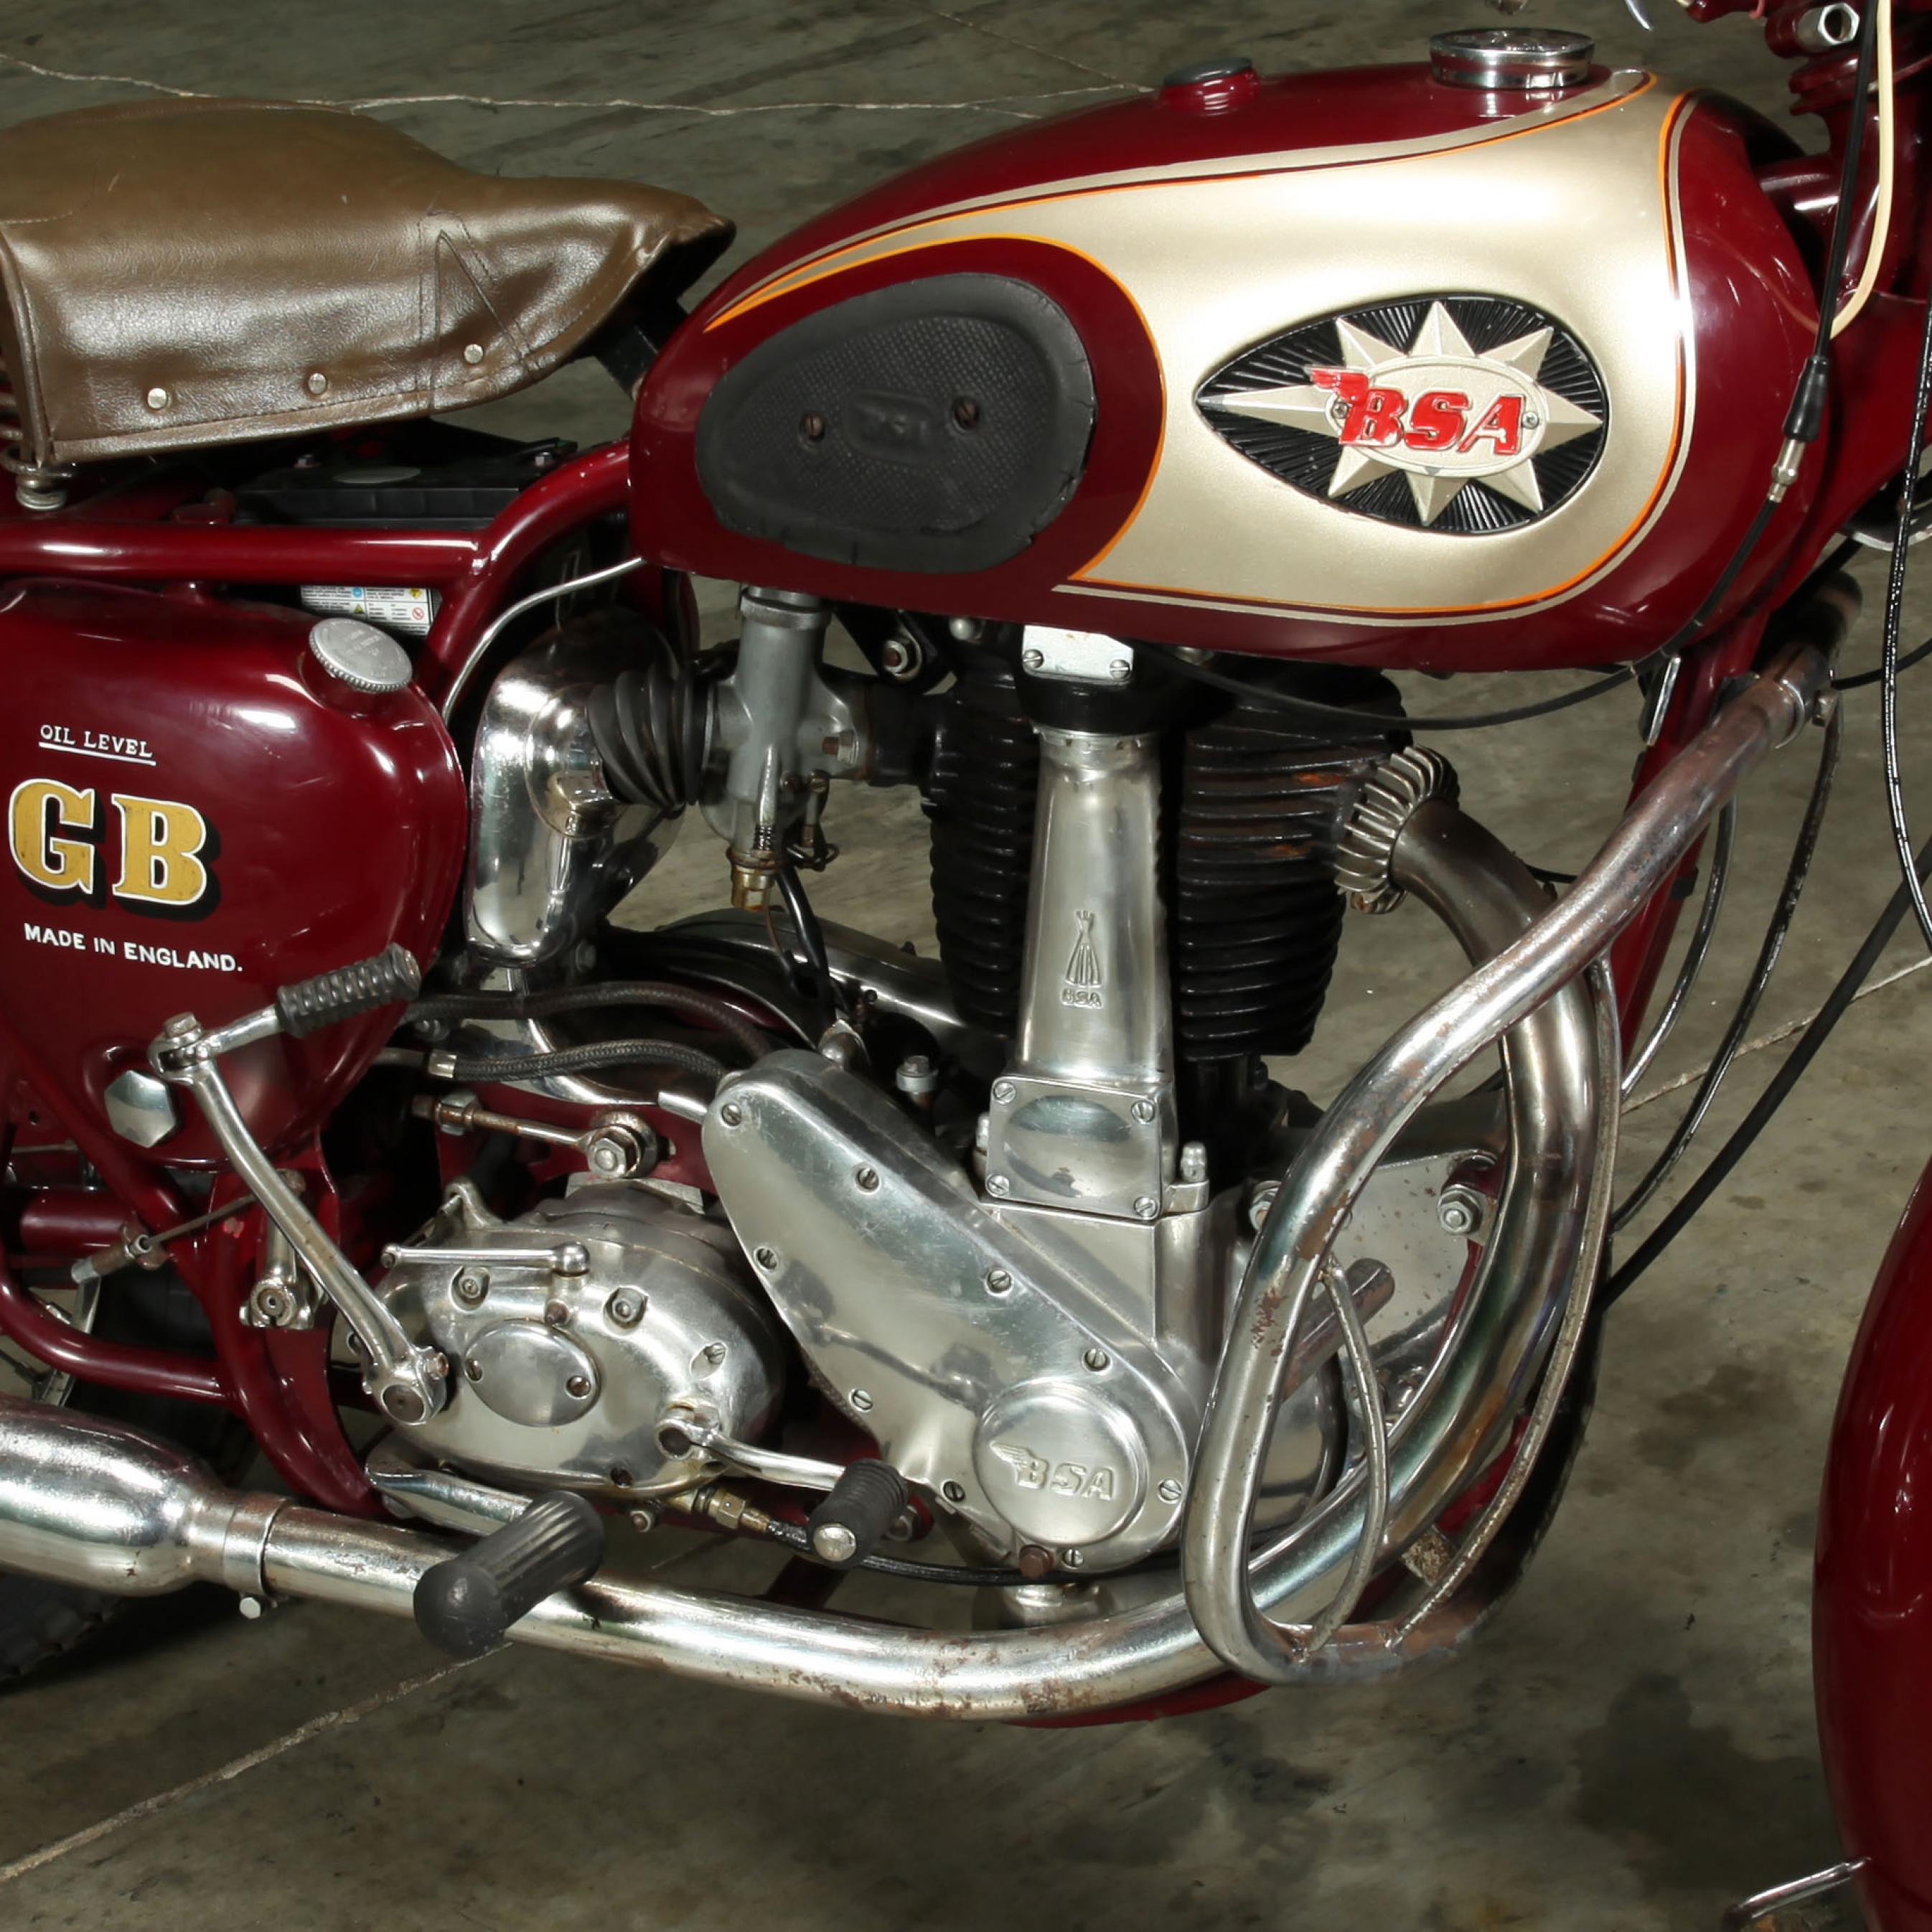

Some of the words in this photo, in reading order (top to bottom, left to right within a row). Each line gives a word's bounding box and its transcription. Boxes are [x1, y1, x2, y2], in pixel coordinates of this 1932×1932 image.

[1324, 376, 1526, 455] BSA
[40, 725, 75, 744] OIL
[84, 731, 153, 758] LEVEL
[9, 778, 207, 906] GB
[24, 923, 86, 949] MADE
[94, 938, 116, 955] IN
[123, 942, 243, 972] ENGLAND.
[1061, 988, 1103, 1009] BSA
[1006, 1450, 1116, 1501] BSA
